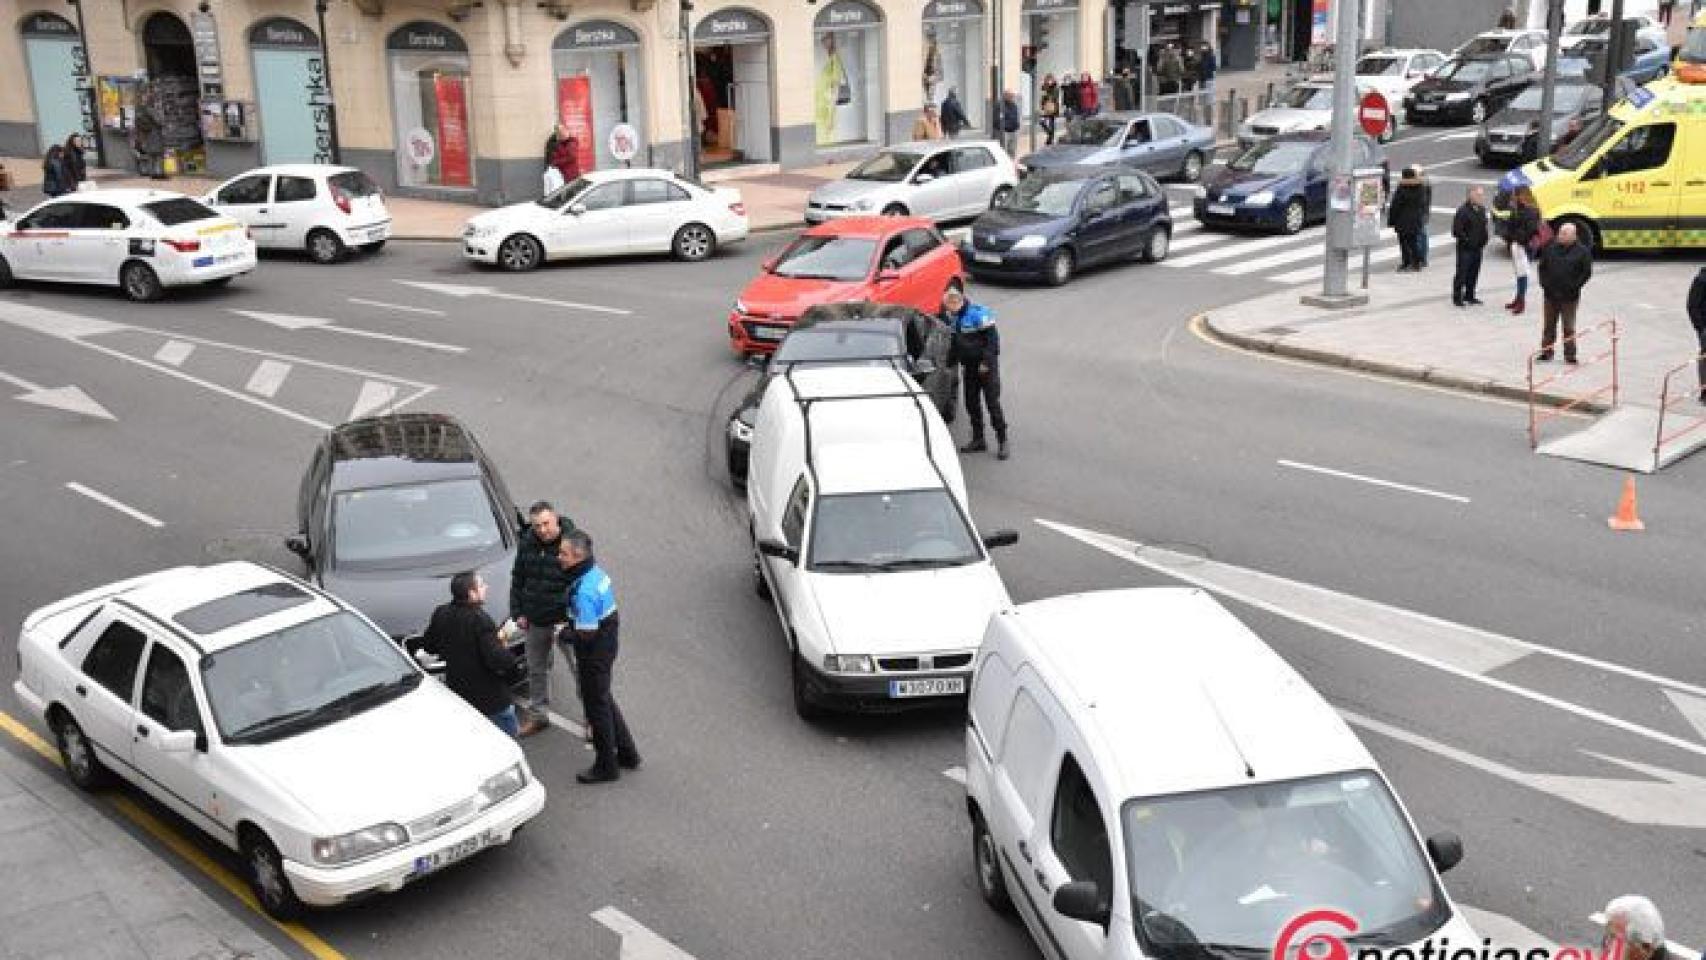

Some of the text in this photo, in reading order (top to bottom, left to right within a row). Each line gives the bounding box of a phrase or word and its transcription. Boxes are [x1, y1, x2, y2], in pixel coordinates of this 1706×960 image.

[712, 20, 748, 33] Bershka
[409, 32, 445, 47] Bershka
[576, 29, 616, 44] Bershka
